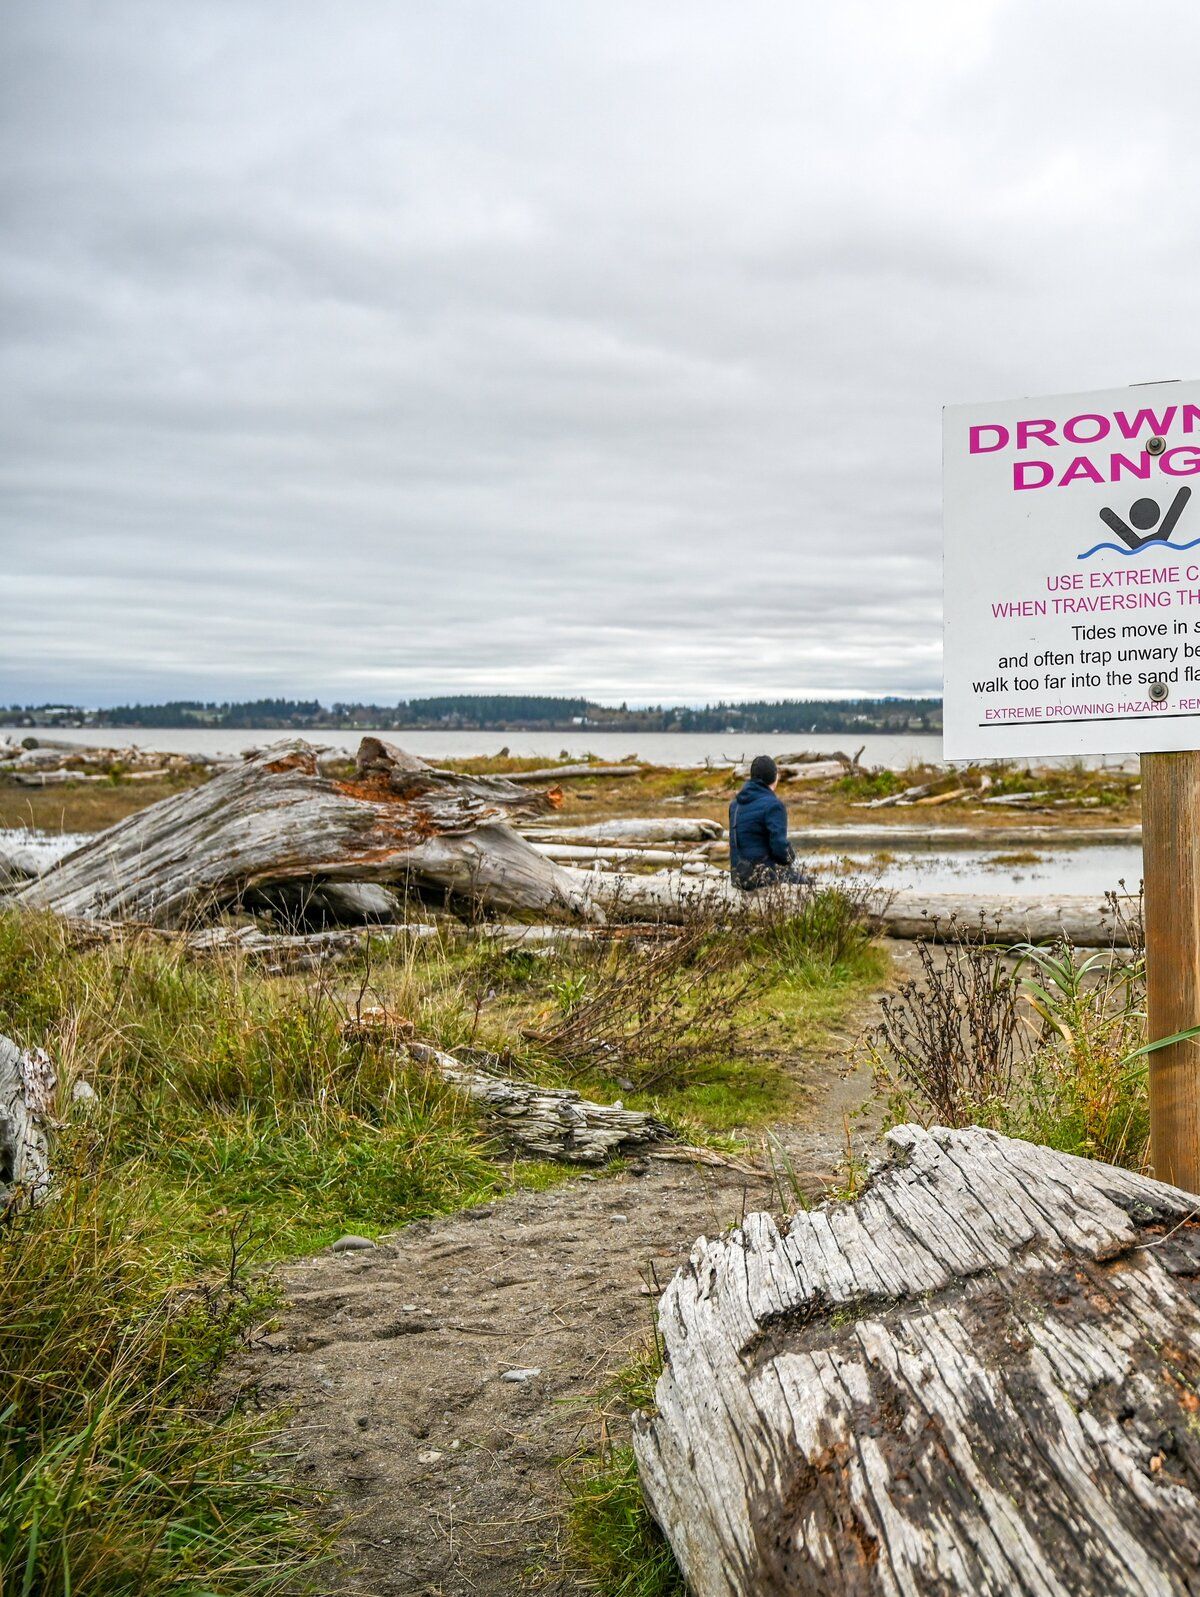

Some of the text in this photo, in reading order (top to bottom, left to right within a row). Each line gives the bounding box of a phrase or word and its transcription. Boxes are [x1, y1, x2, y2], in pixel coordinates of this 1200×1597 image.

[1047, 574, 1083, 591] USE
[1090, 567, 1179, 588] EXTREME
[992, 600, 1046, 618] WHEN
[1052, 591, 1171, 614] TRAVERSING
[1072, 625, 1116, 641] Tides
[1122, 623, 1167, 638] move
[1174, 619, 1187, 634] in
[998, 653, 1028, 668] and
[1034, 652, 1074, 666] often
[1080, 650, 1111, 666] trap
[1118, 647, 1178, 662] unwary
[973, 677, 1009, 693] walk
[1014, 677, 1038, 691] too
[1044, 675, 1066, 689] far
[1071, 673, 1100, 688] into
[1107, 671, 1132, 685] the
[1138, 667, 1178, 684] sand
[986, 707, 1042, 719] EXTREME
[1046, 703, 1114, 716] DROWNING
[1118, 701, 1167, 712] HAZARD
